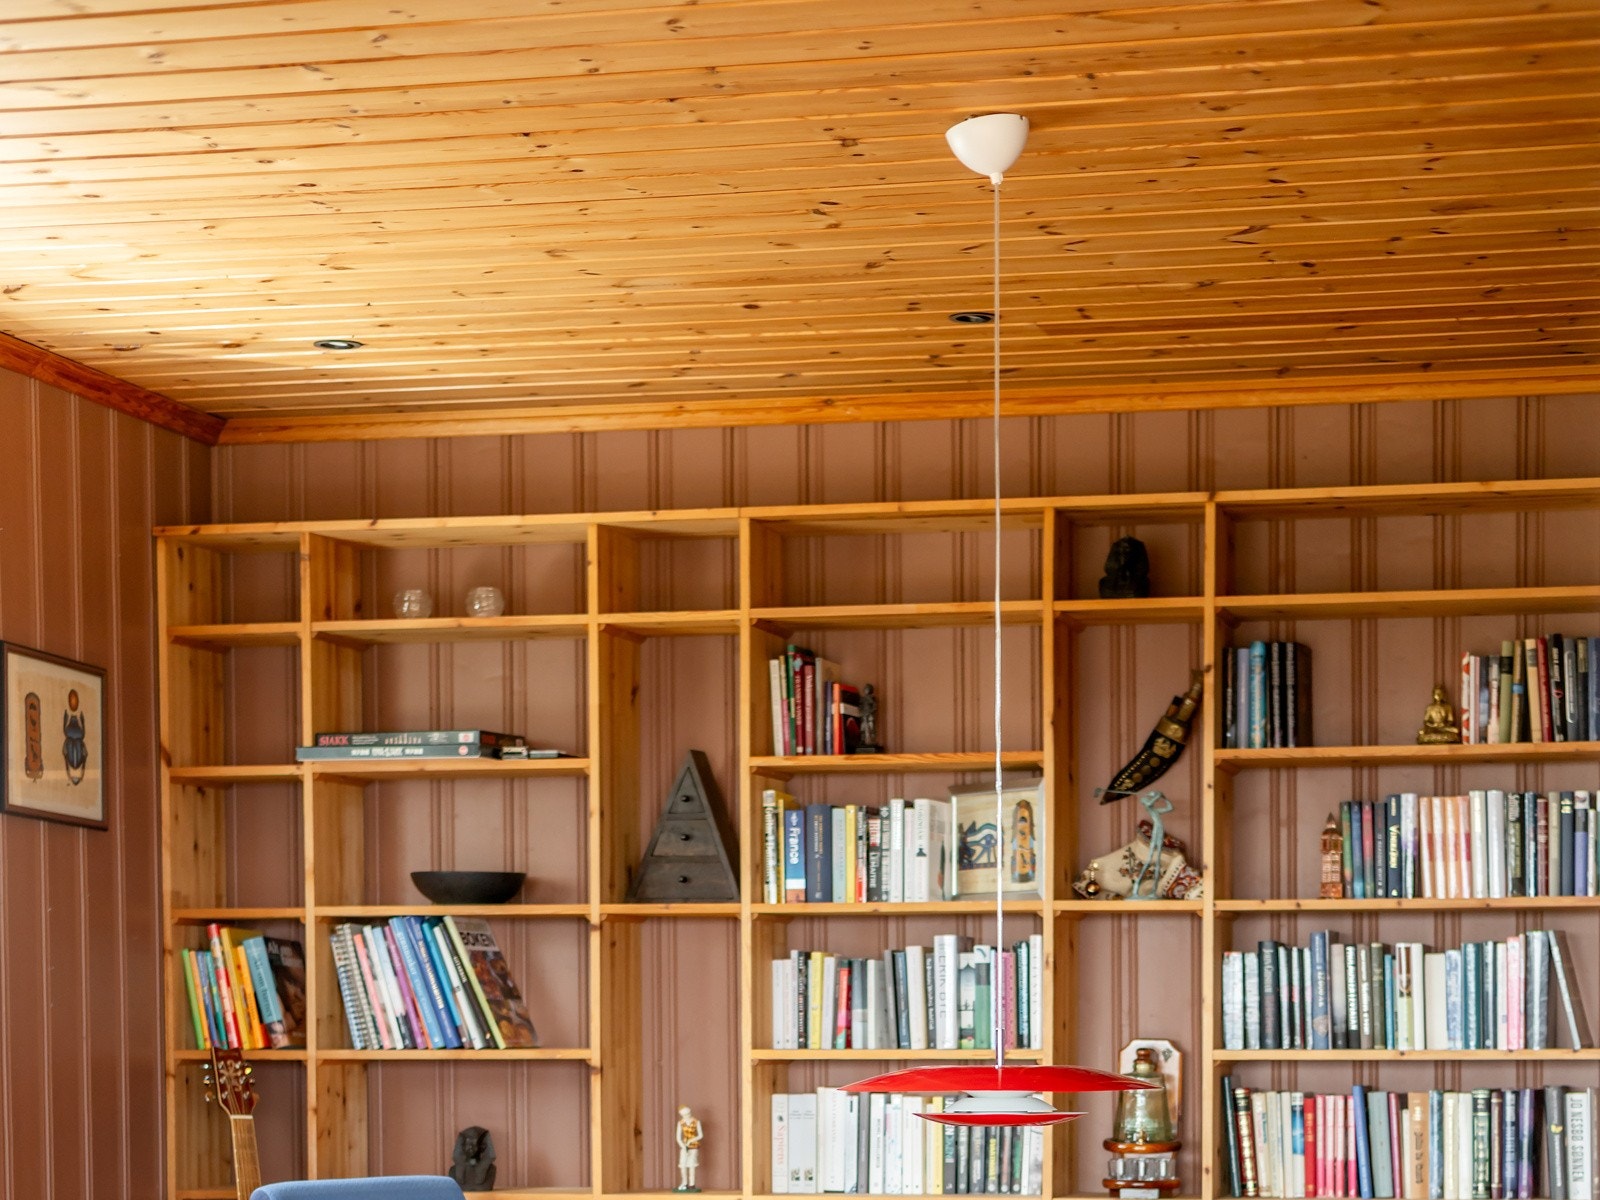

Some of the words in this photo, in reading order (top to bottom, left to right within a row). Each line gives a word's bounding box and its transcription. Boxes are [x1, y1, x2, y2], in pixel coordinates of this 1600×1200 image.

[789, 827, 801, 865] France
[1570, 1098, 1583, 1108] JO
[1571, 1112, 1583, 1142] NESBØ
[1572, 1145, 1584, 1183] SØNNEN
